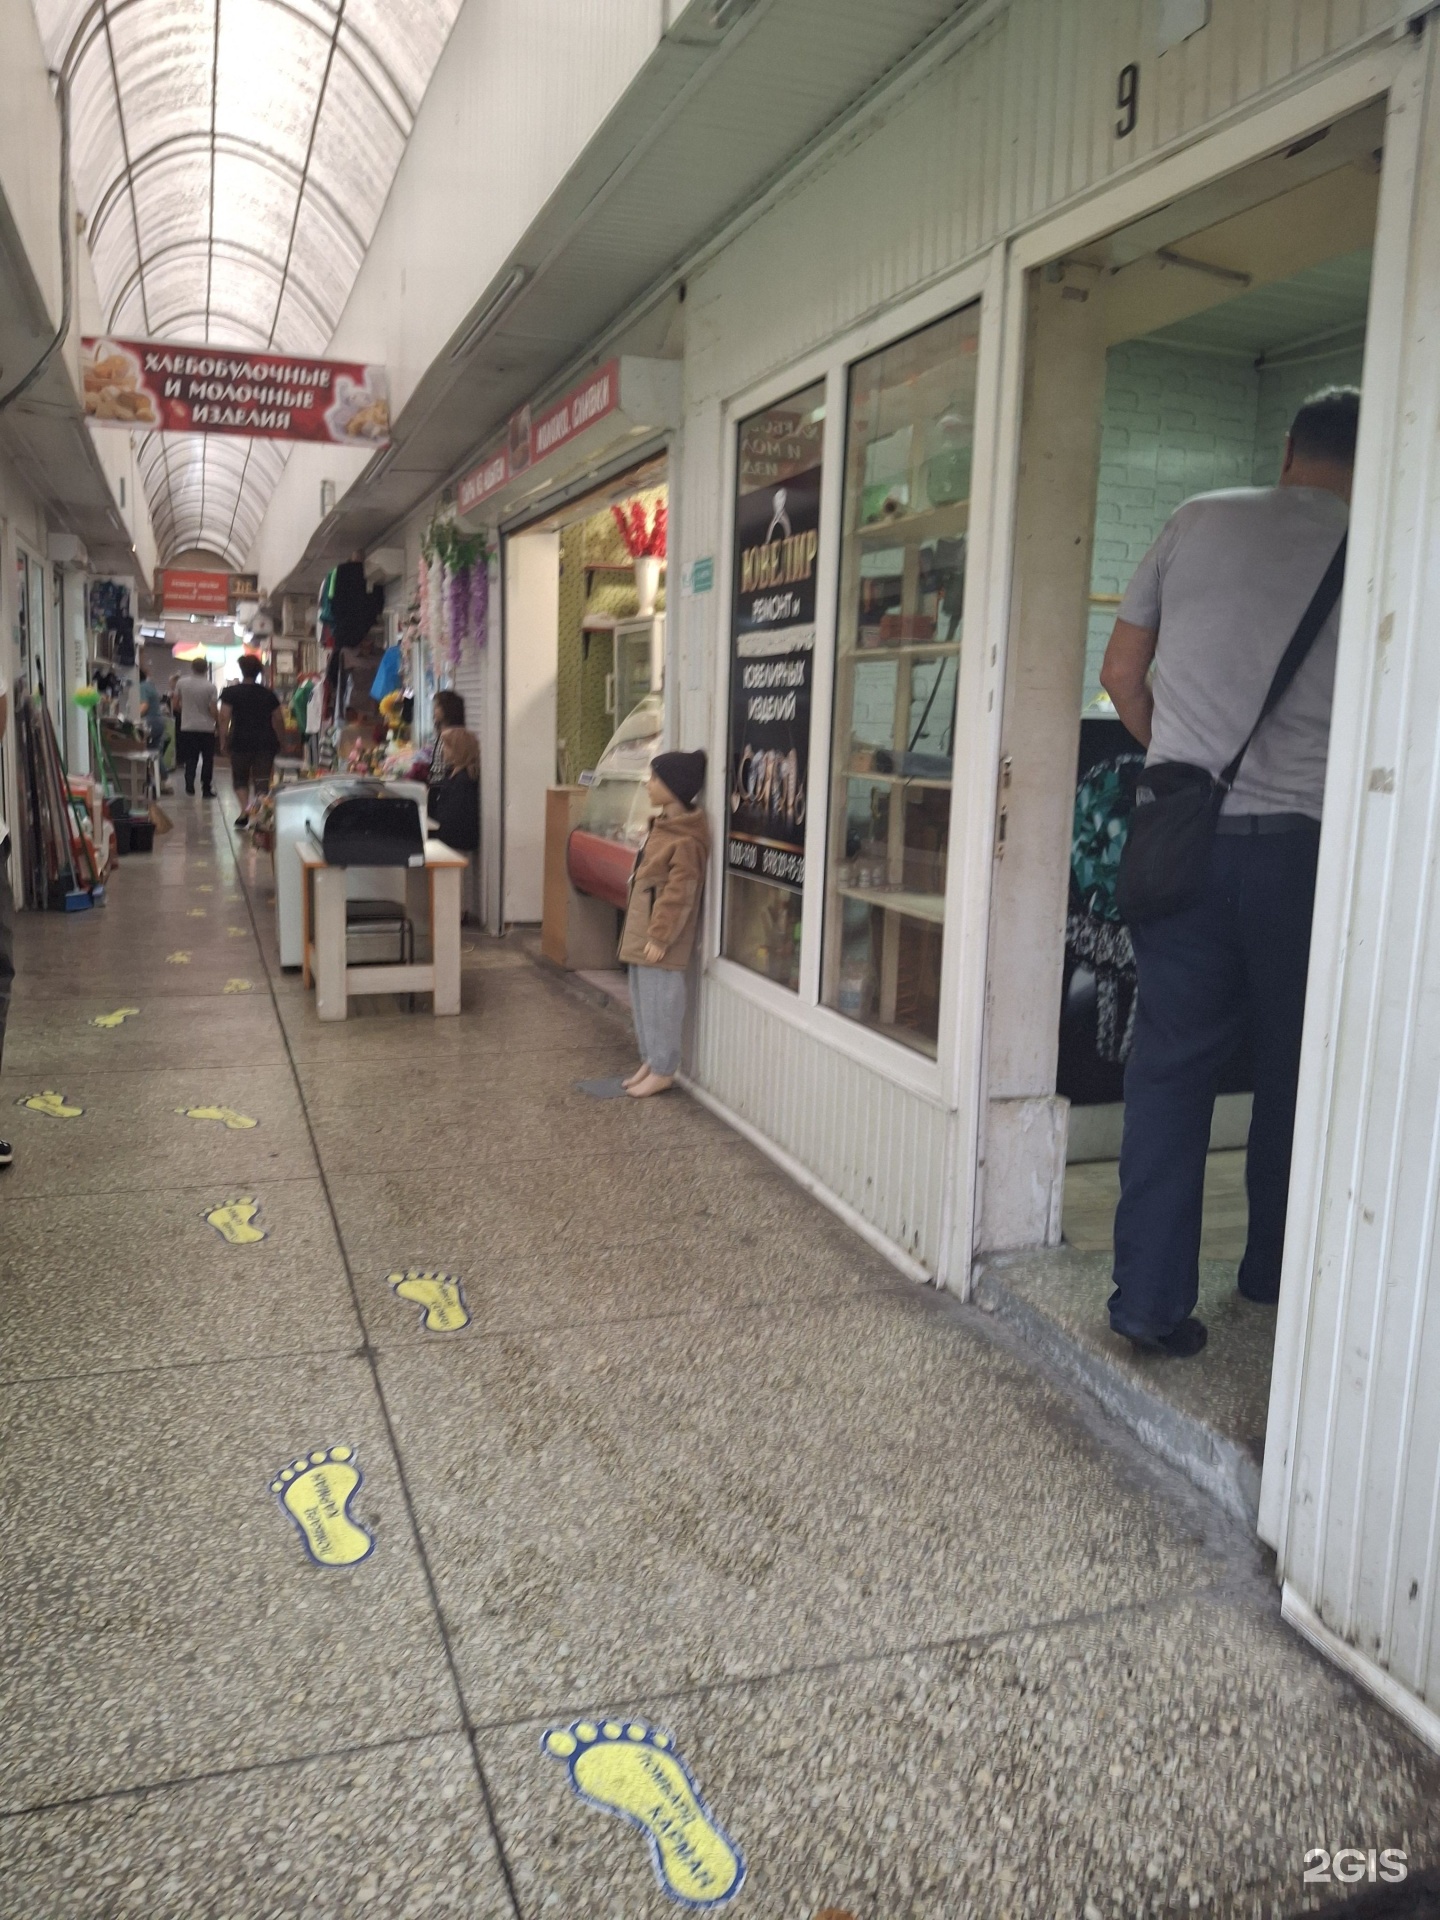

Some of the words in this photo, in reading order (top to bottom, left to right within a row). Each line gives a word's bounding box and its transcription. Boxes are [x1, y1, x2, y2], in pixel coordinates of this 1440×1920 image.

[1116, 62, 1138, 138] 9
[144, 352, 332, 388] ХЛЕБОБУЛОЧНЫЕ
[164, 378, 182, 398] И
[188, 380, 314, 409] МОЛОЧНЫЕ
[192, 404, 291, 429] ИЗДЕЛИЯ
[741, 528, 817, 594] ЮВЕЛИР
[752, 592, 793, 623] РЕМОНТ
[743, 660, 805, 688] ЮВЕЛИРНЫХ
[748, 690, 796, 723] ИЗДЕЛИЙ
[648, 1805, 717, 1889] КАРМАН
